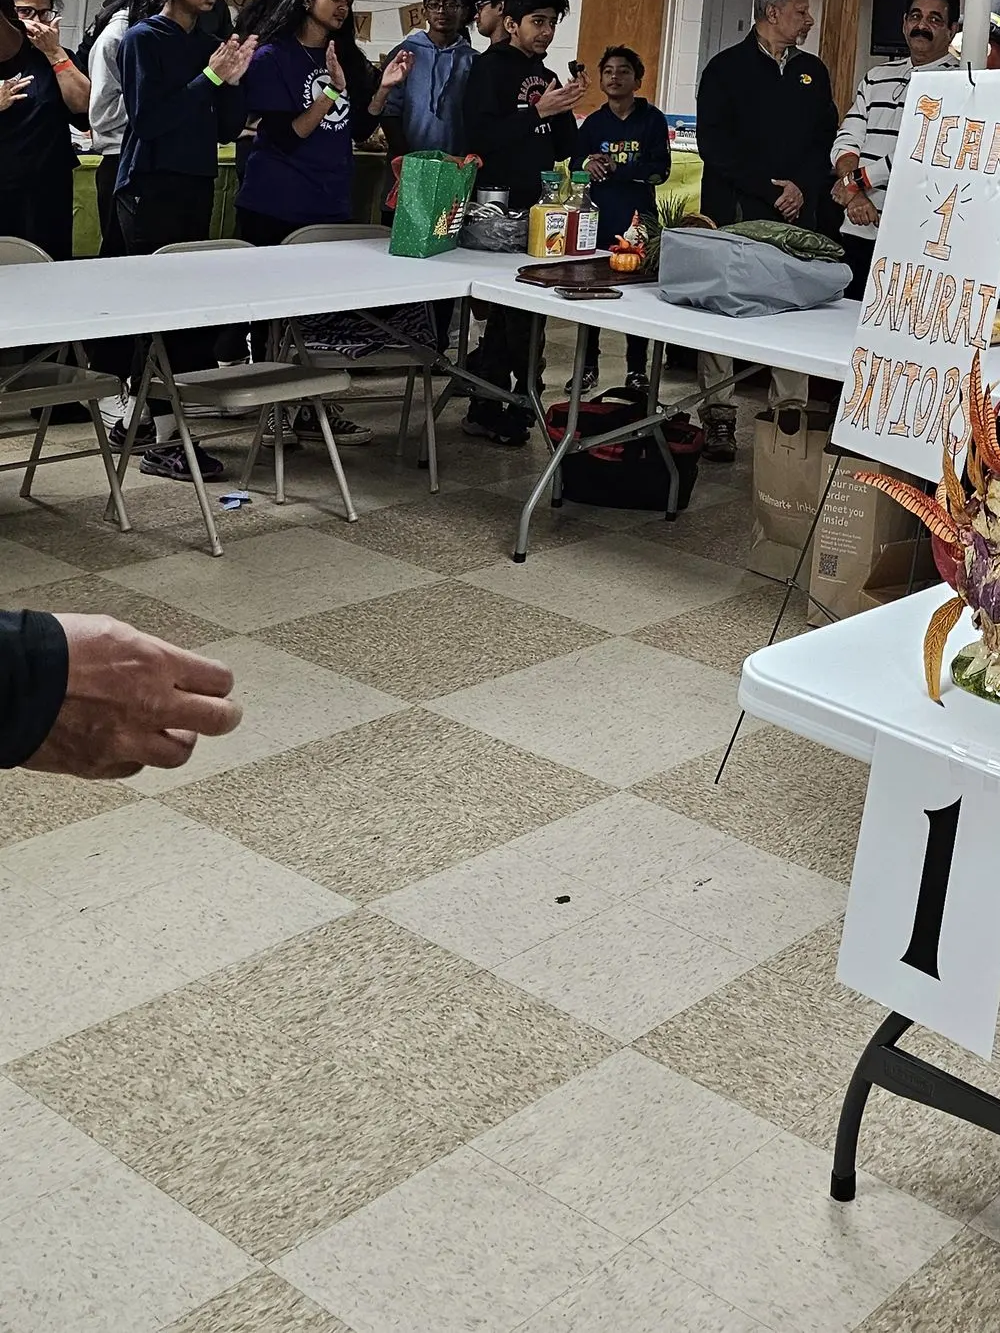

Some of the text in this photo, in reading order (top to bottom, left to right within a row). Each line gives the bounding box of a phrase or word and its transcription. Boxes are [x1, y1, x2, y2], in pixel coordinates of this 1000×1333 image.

[600, 140, 640, 153] SUPER
[923, 184, 959, 261] 1
[862, 257, 997, 350] SAMURAI
[840, 346, 972, 456] SAVIORS
[827, 479, 868, 493] our next
[826, 491, 850, 502] order
[796, 501, 817, 515] InHo
[824, 504, 864, 518] meet you
[823, 513, 849, 527] inside
[900, 794, 963, 981] 1
